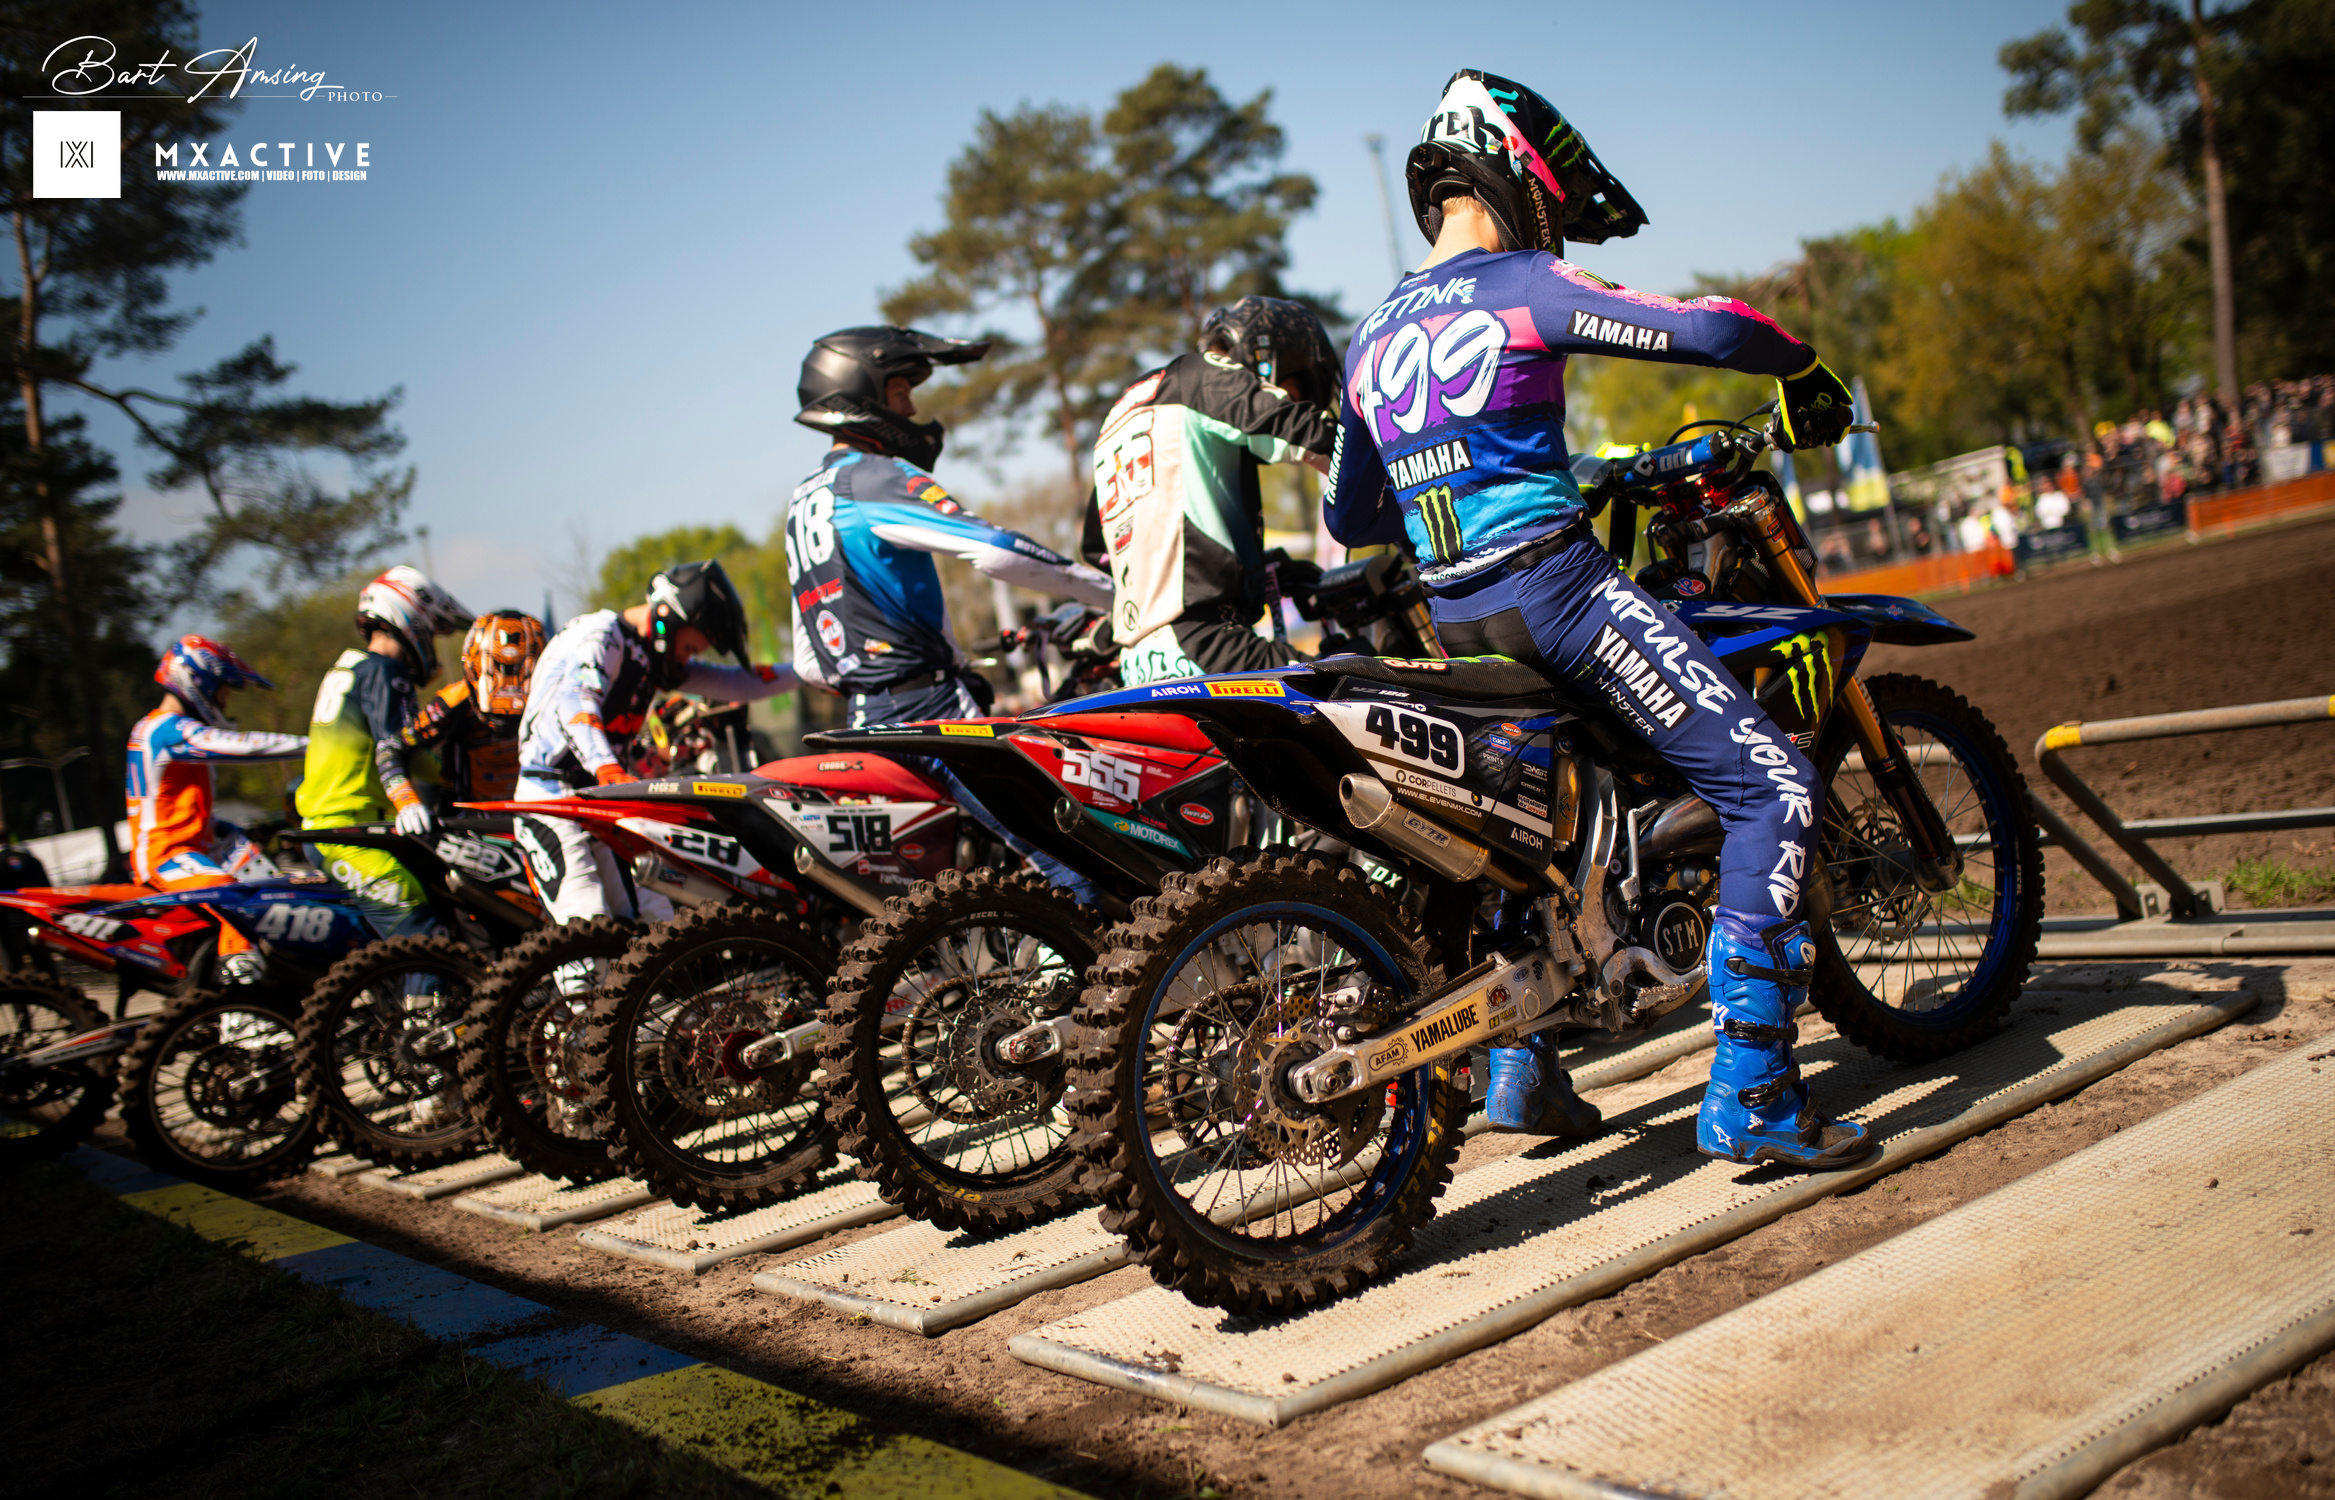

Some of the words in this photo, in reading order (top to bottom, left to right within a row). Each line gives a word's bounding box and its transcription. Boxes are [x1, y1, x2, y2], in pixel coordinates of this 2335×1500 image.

[1528, 177, 1551, 248] MONSTER
[1571, 310, 1669, 352] YAMAHA
[1357, 309, 1507, 447] 499
[1326, 423, 1346, 505] YAMAHA
[1388, 440, 1471, 490] YAMAHA
[785, 486, 835, 586] 518
[1691, 604, 1814, 620] YZ
[1383, 659, 1447, 671] GUTS
[1594, 625, 1687, 728] YAMAHA
[1151, 685, 1201, 698] AIROH
[1212, 682, 1280, 695] PIRELLI
[1595, 677, 1655, 736] MONSTER
[1365, 704, 1458, 772] 499
[1492, 735, 1508, 745] SKF
[1483, 752, 1504, 766] PRINTS
[1730, 717, 1814, 828] YOUR
[648, 782, 680, 793] HGS
[1061, 748, 1143, 805] 555
[1408, 774, 1457, 797] CORPELLETS
[1183, 807, 1201, 819] Twin
[1200, 811, 1212, 820] Air
[1398, 787, 1482, 818] WWW.ELEVENMX.COM
[825, 814, 891, 853] 518
[1130, 823, 1180, 851] MOTOREX
[1406, 816, 1449, 845] GYTR
[1510, 827, 1543, 850] AIROH
[1361, 861, 1403, 888] FOX
[1767, 840, 1806, 918] RID
[256, 903, 335, 943] 418
[970, 910, 999, 920] EXCEL
[1662, 918, 1699, 956] STM
[1410, 1004, 1480, 1053] YAMALUBE
[1375, 1048, 1400, 1067] AFAM
